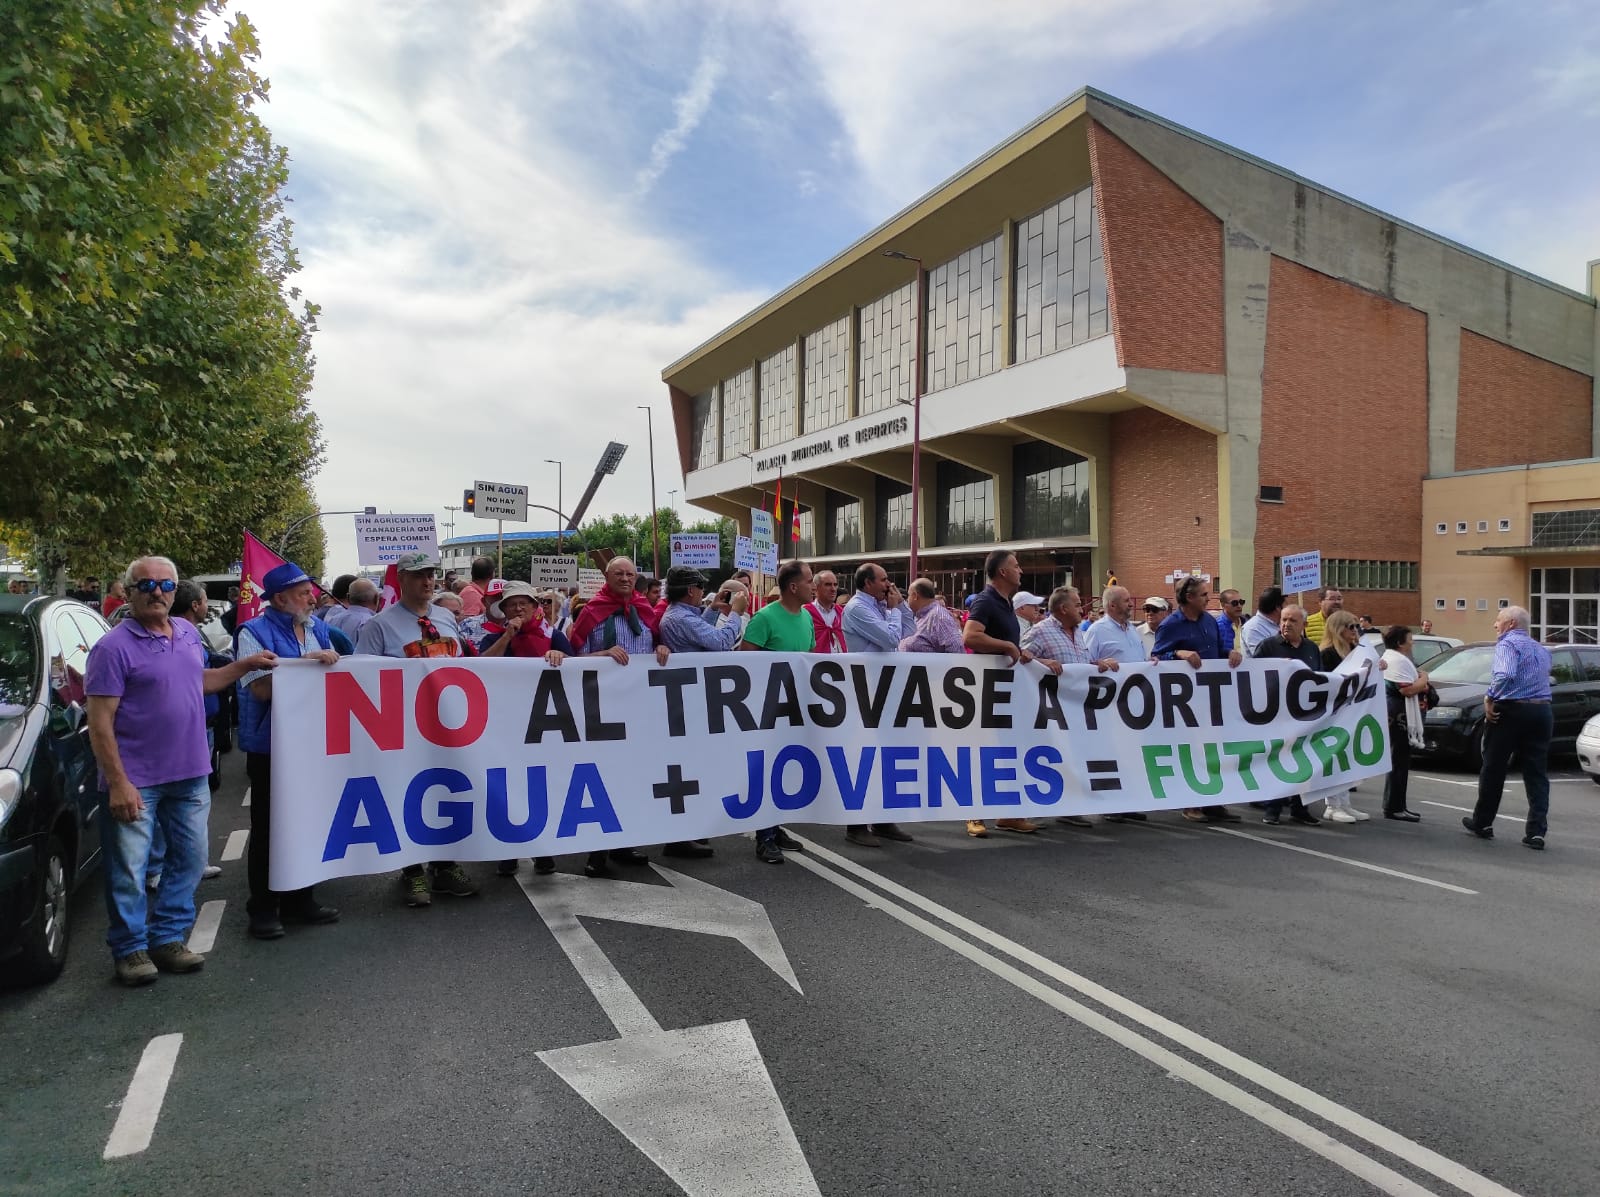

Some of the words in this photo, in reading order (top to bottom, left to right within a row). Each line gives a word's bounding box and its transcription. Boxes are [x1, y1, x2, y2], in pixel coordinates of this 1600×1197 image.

[757, 454, 787, 472] PALACIO
[791, 440, 833, 462] MUNICIPAL
[838, 434, 849, 449] DE
[855, 417, 908, 443] DEPORTES
[478, 483, 495, 492] SIN
[498, 486, 524, 496] AGUA
[485, 506, 516, 515] FUTURO
[365, 525, 415, 533] GANADERÍA
[533, 557, 549, 565] SIN
[326, 667, 488, 756] NO
[524, 669, 627, 745] AL
[648, 661, 1015, 738] TRASVASE
[1034, 674, 1069, 731] A
[1084, 658, 1378, 732] PORTUGAL
[321, 762, 624, 864] AGUA
[653, 764, 700, 815] +
[720, 744, 1065, 821] JOVENES
[1087, 759, 1122, 792] =
[1143, 714, 1385, 800] FUTURO
